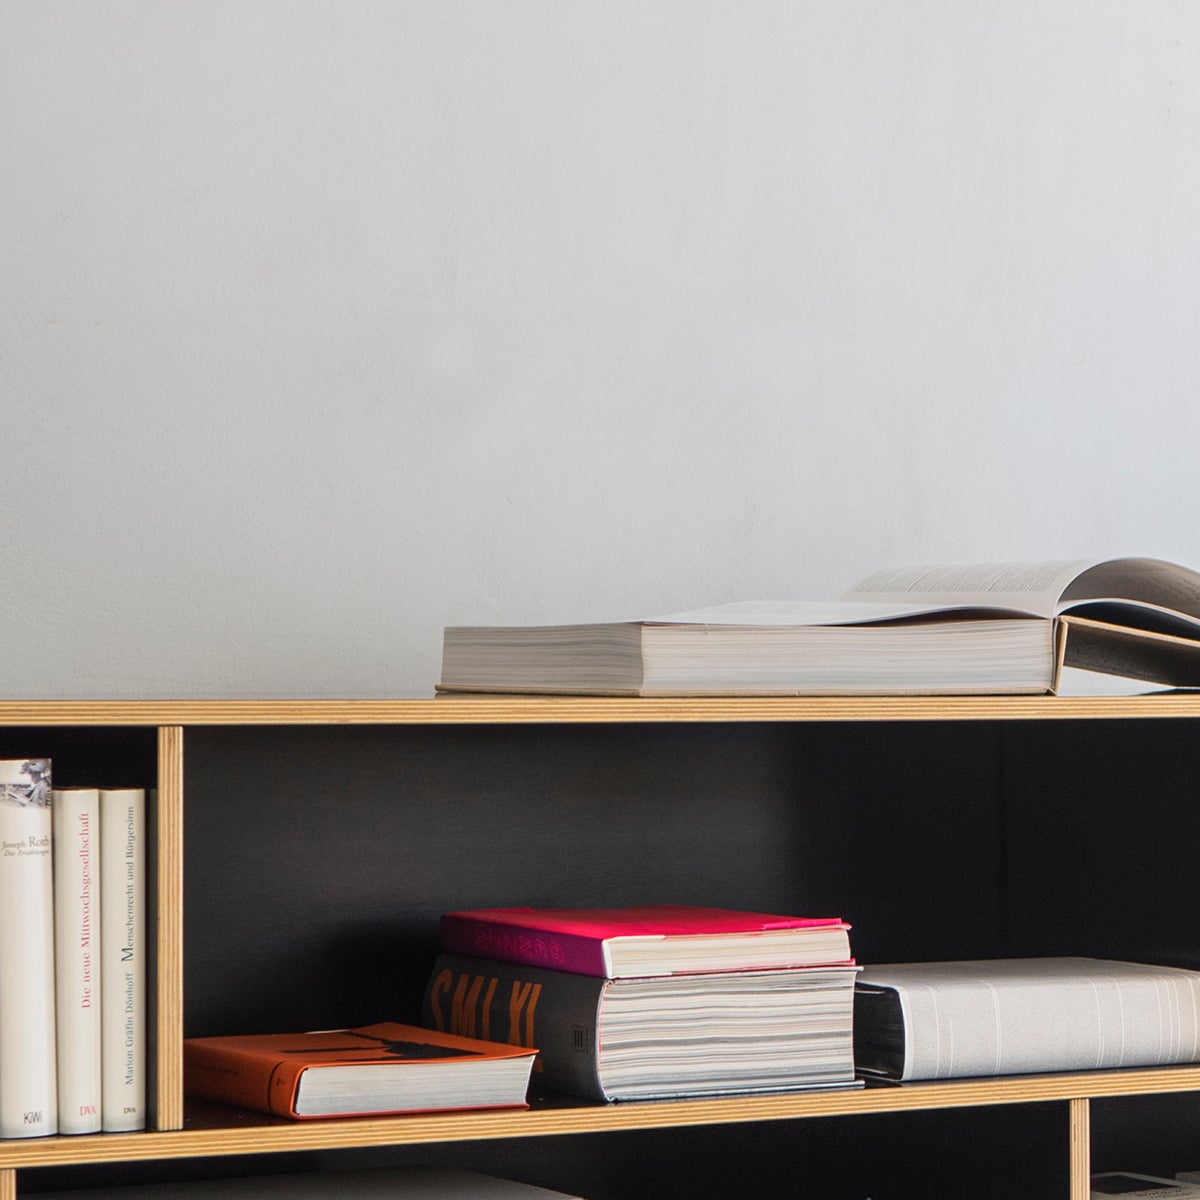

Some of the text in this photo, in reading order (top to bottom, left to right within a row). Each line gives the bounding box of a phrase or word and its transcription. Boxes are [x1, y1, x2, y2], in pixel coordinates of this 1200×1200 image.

[79, 813, 92, 1008] Die neue Mittwochsgesellschaft
[121, 806, 136, 962] Menschenrecht und Bürgersinn
[124, 972, 134, 1085] Marion Gräfin Dönhoff
